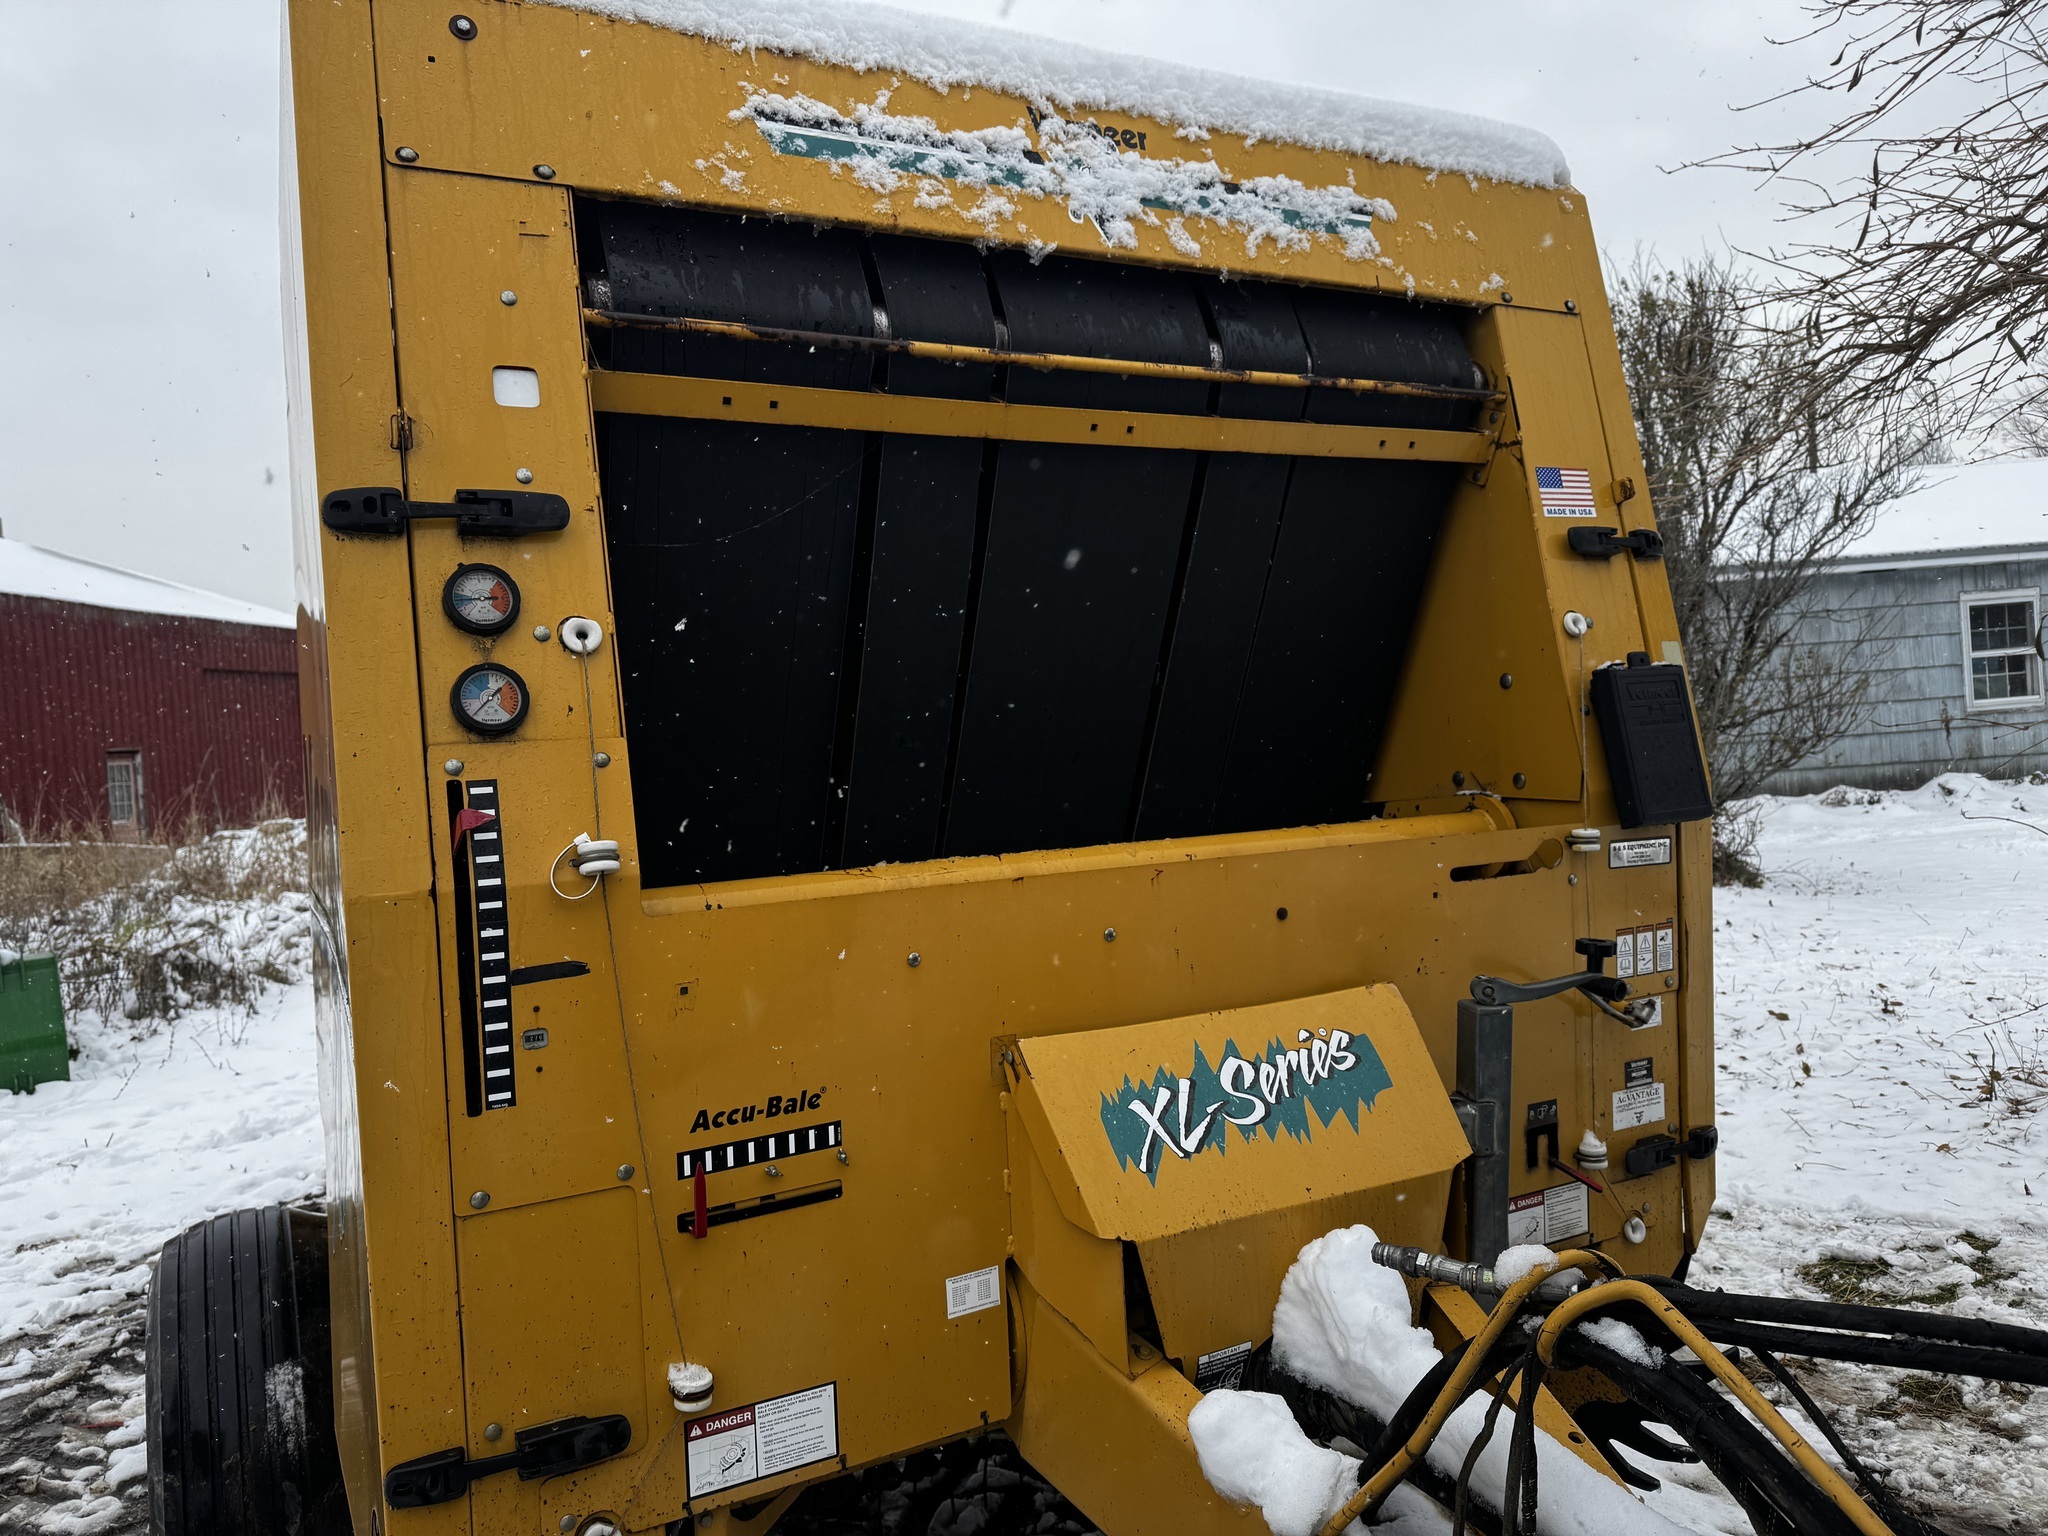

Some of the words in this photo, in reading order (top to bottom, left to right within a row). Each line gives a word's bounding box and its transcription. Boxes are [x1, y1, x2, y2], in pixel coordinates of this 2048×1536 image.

[1578, 508, 1593, 516] USA
[1219, 1027, 1361, 1127] Series
[1517, 1195, 1543, 1209] DANGER
[1210, 1346, 1241, 1359] IMPORTANT
[706, 1411, 752, 1432] DANGER
